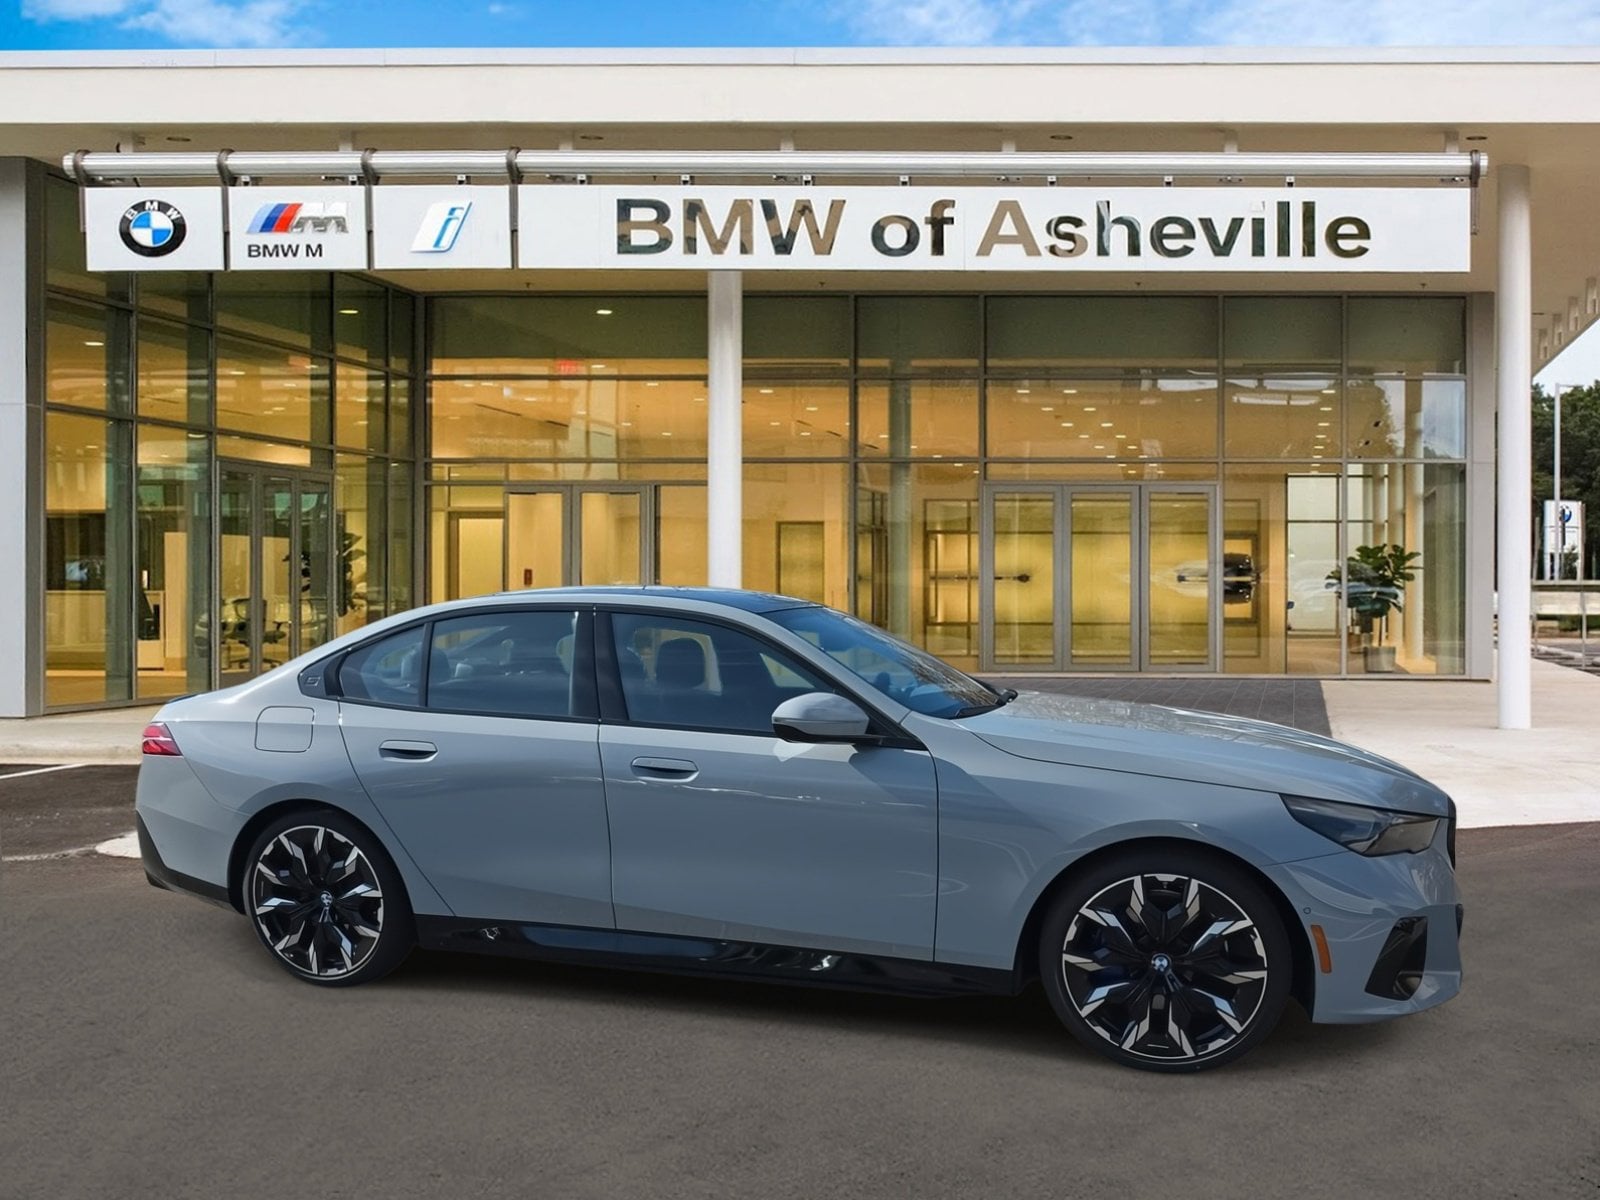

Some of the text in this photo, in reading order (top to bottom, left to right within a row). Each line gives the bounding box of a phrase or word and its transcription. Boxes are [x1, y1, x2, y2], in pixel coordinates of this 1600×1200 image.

[125, 201, 180, 220] BMW
[616, 199, 1372, 259] BMW of Asheville
[247, 243, 323, 258] BMW M
